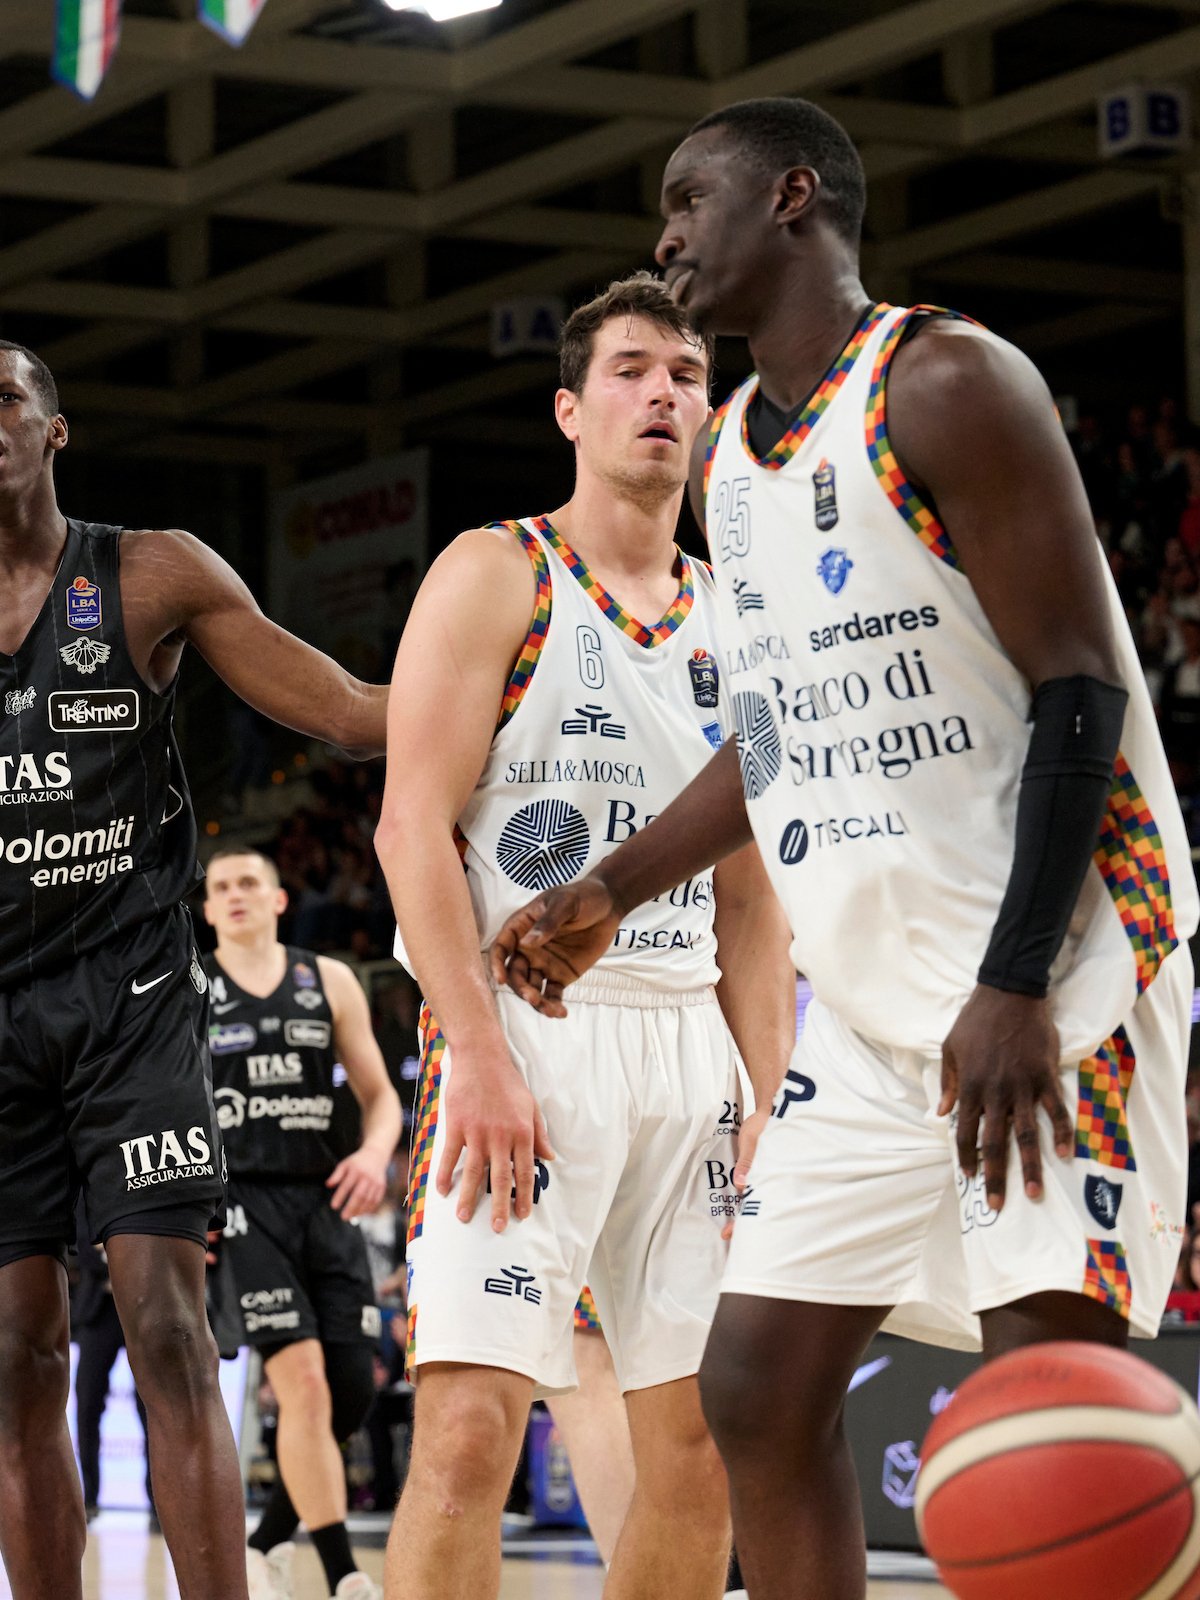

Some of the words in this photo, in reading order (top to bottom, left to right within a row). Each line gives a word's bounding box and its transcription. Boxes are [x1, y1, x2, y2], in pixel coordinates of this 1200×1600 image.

[72, 598, 98, 608] LBA
[810, 605, 940, 652] sardares
[576, 625, 605, 690] 6
[884, 649, 936, 701] di
[57, 702, 130, 725] TRENTINO
[786, 714, 976, 786] Saregna
[505, 758, 647, 789] SELLA&MOSCA
[30, 854, 134, 888] energia
[119, 1126, 211, 1180] ITAS
[126, 1164, 215, 1192] ASSICURAZIONI
[709, 1192, 742, 1206] Grupp
